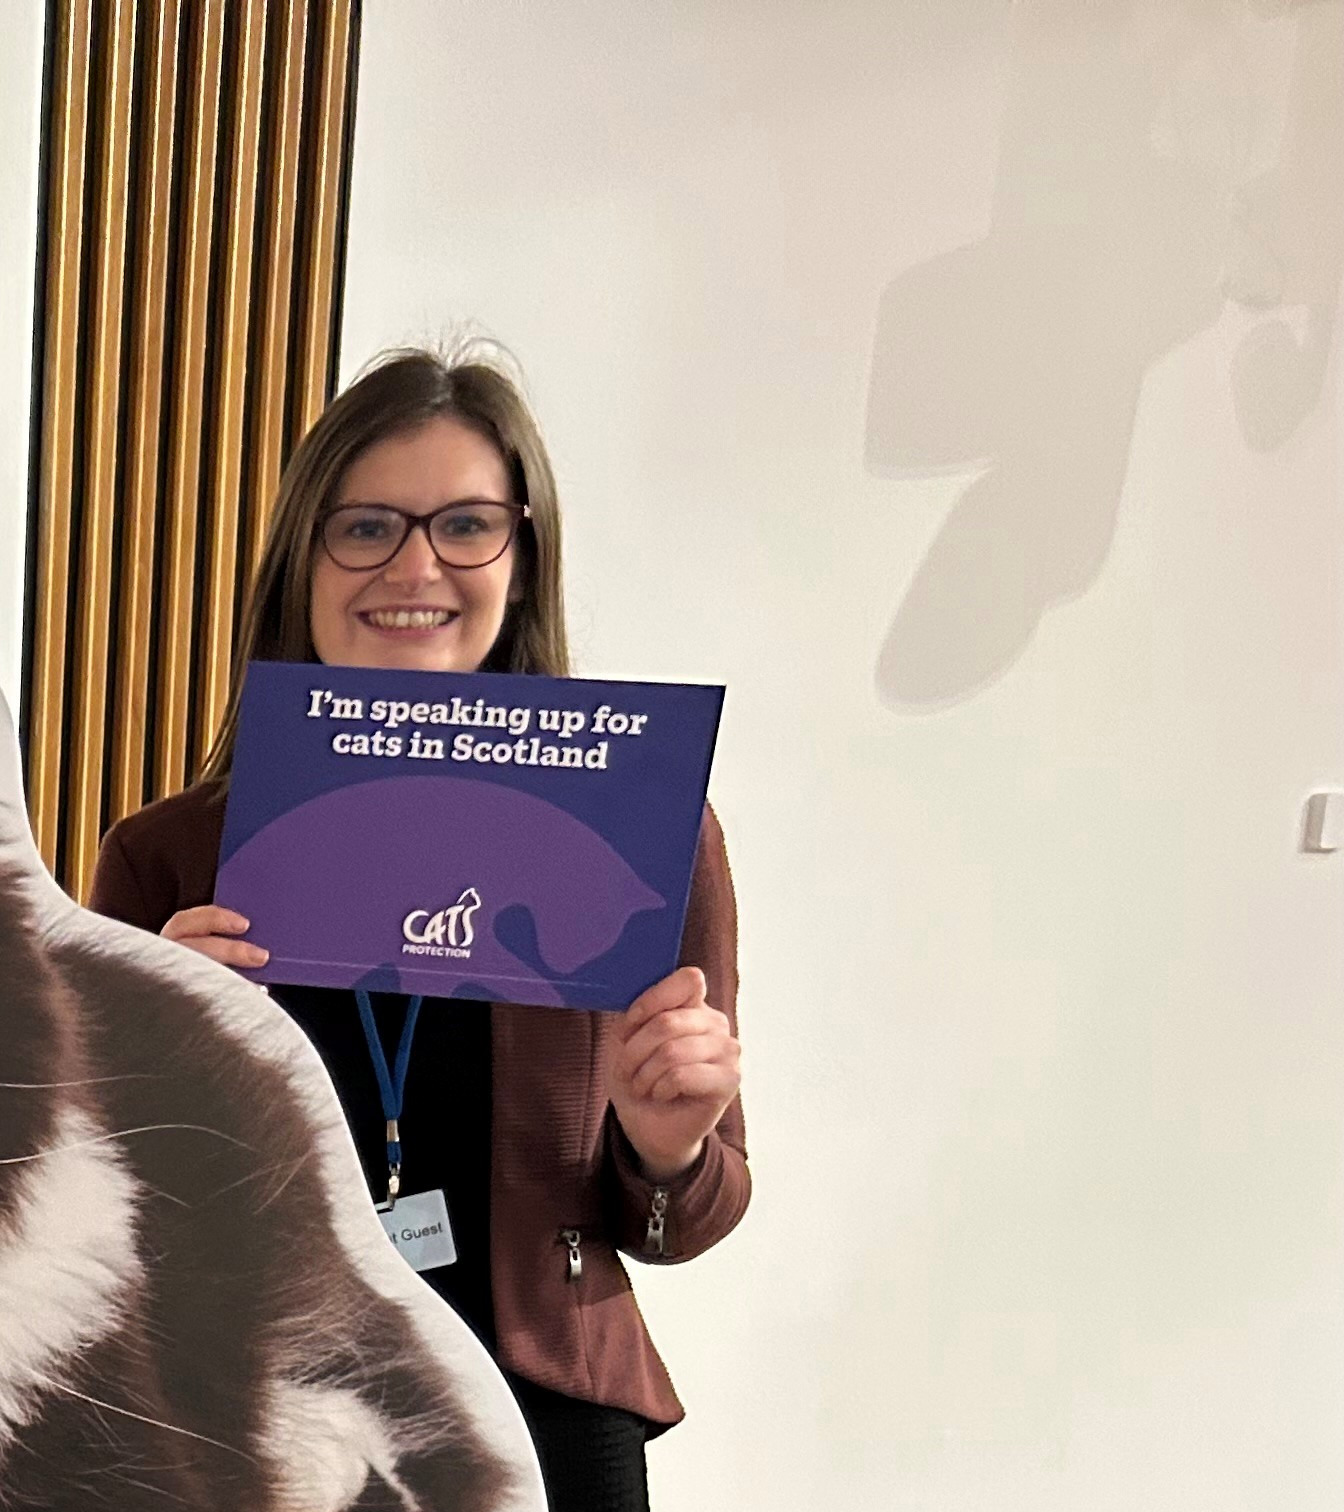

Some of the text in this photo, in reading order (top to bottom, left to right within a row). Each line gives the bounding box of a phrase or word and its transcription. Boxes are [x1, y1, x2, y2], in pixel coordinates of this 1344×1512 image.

[306, 689, 648, 738] I’m speaking up for
[331, 730, 609, 769] cats in Scotland
[402, 896, 481, 947] CATS
[402, 943, 471, 959] PROTECTION
[400, 1221, 443, 1241] Guest
